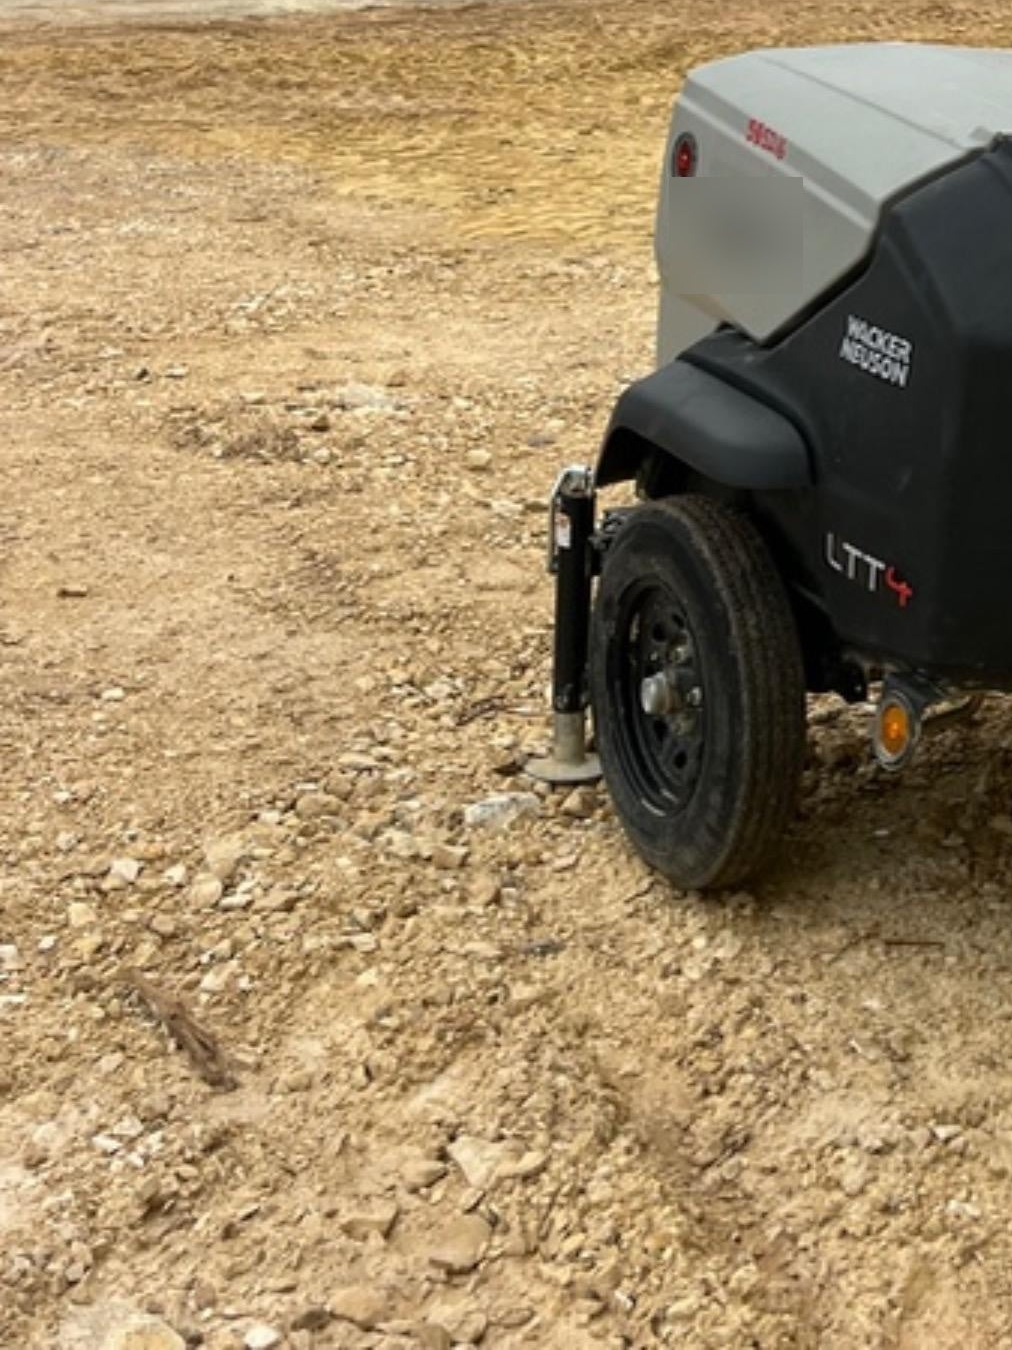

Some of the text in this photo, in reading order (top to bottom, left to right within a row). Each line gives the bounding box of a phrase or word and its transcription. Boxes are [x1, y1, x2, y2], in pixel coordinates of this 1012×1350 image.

[840, 337, 910, 386] NEUSON
[848, 314, 912, 363] WACKER
[827, 533, 913, 607] LTT4
